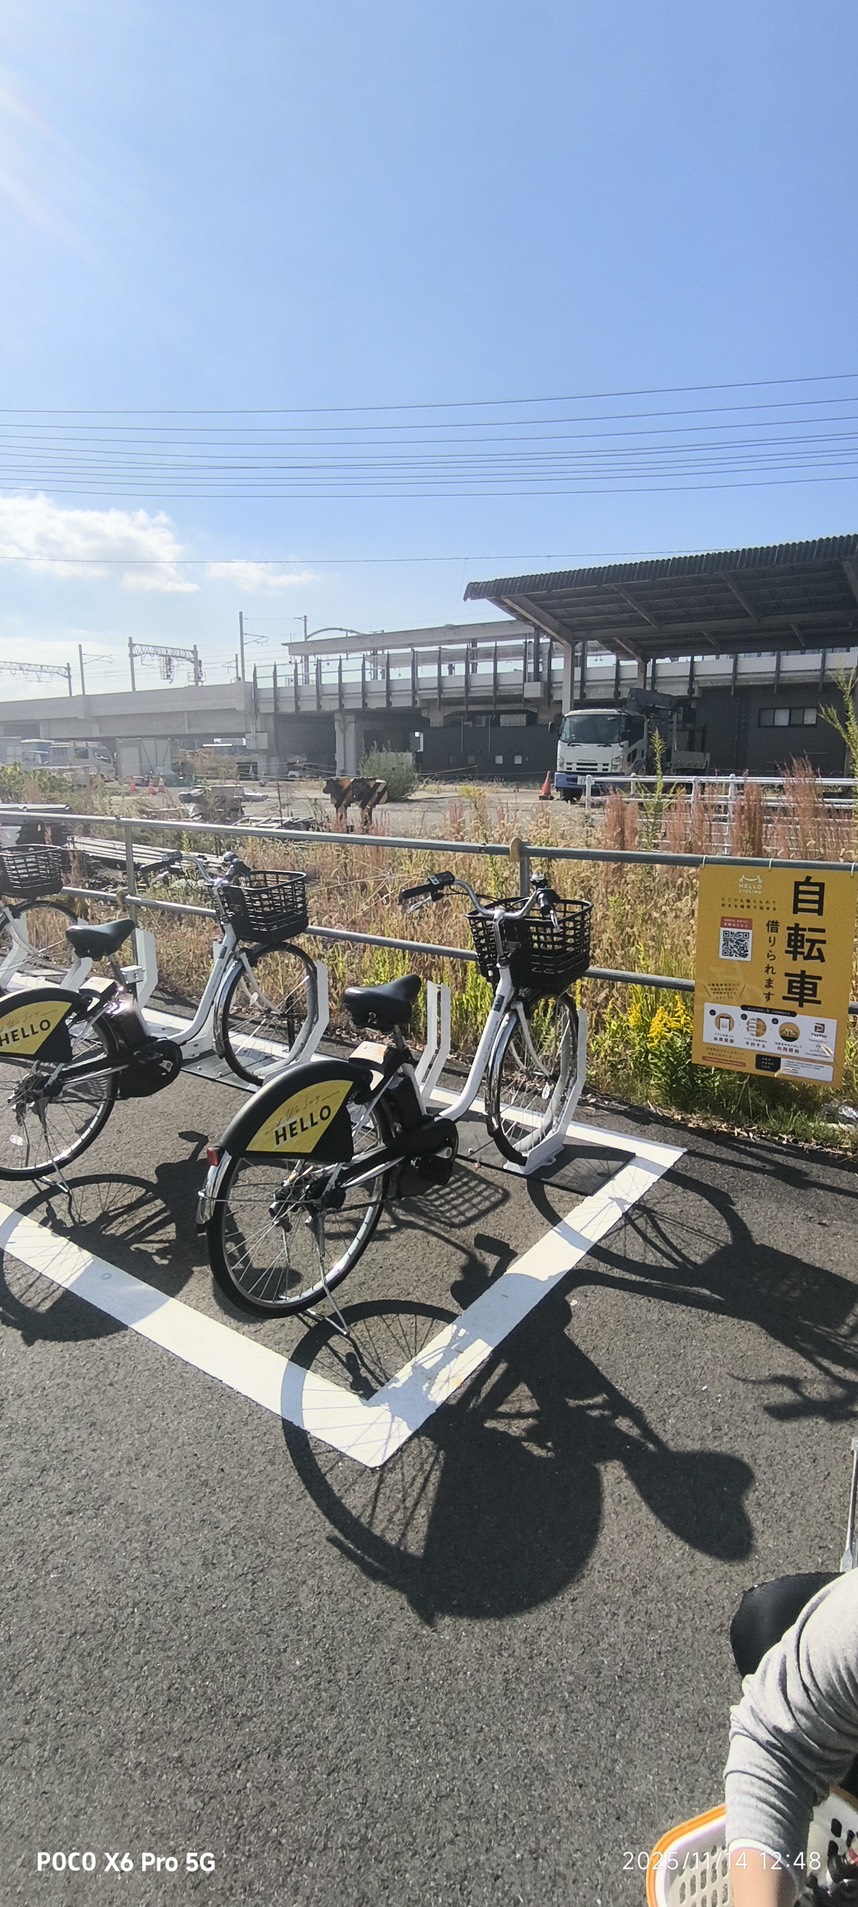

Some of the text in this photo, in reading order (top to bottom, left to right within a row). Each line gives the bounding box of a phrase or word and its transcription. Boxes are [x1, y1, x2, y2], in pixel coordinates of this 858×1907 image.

[763, 919, 780, 1003] 借りられます
[782, 876, 827, 1008] 自転車
[0, 1019, 51, 1047] HELLO
[274, 1105, 332, 1146] HELLO
